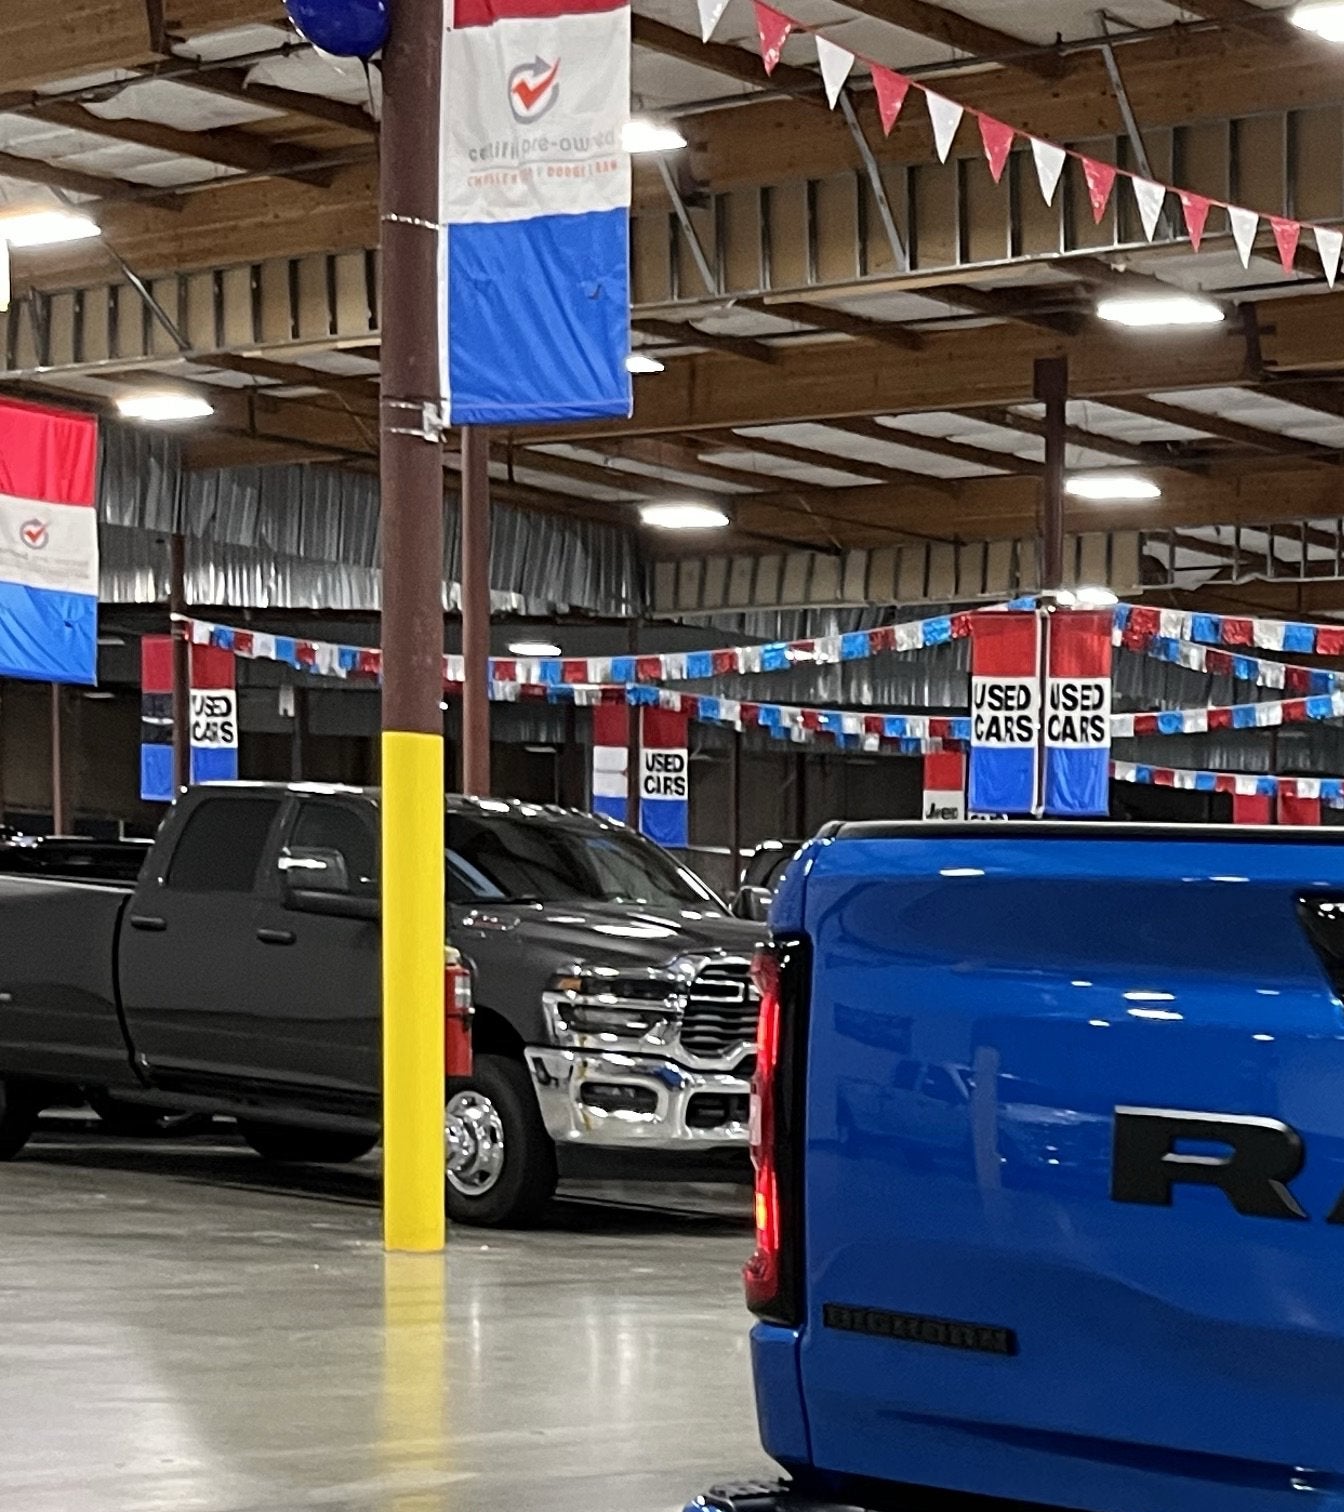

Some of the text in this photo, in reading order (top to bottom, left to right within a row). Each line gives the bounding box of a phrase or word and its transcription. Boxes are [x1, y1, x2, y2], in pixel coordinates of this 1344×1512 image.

[467, 129, 615, 163] certifi pre-owed
[975, 683, 1031, 711] USED
[1050, 683, 1105, 711] USED
[975, 714, 1033, 742] CARS
[1048, 714, 1105, 742] CARS
[646, 752, 684, 773] USED
